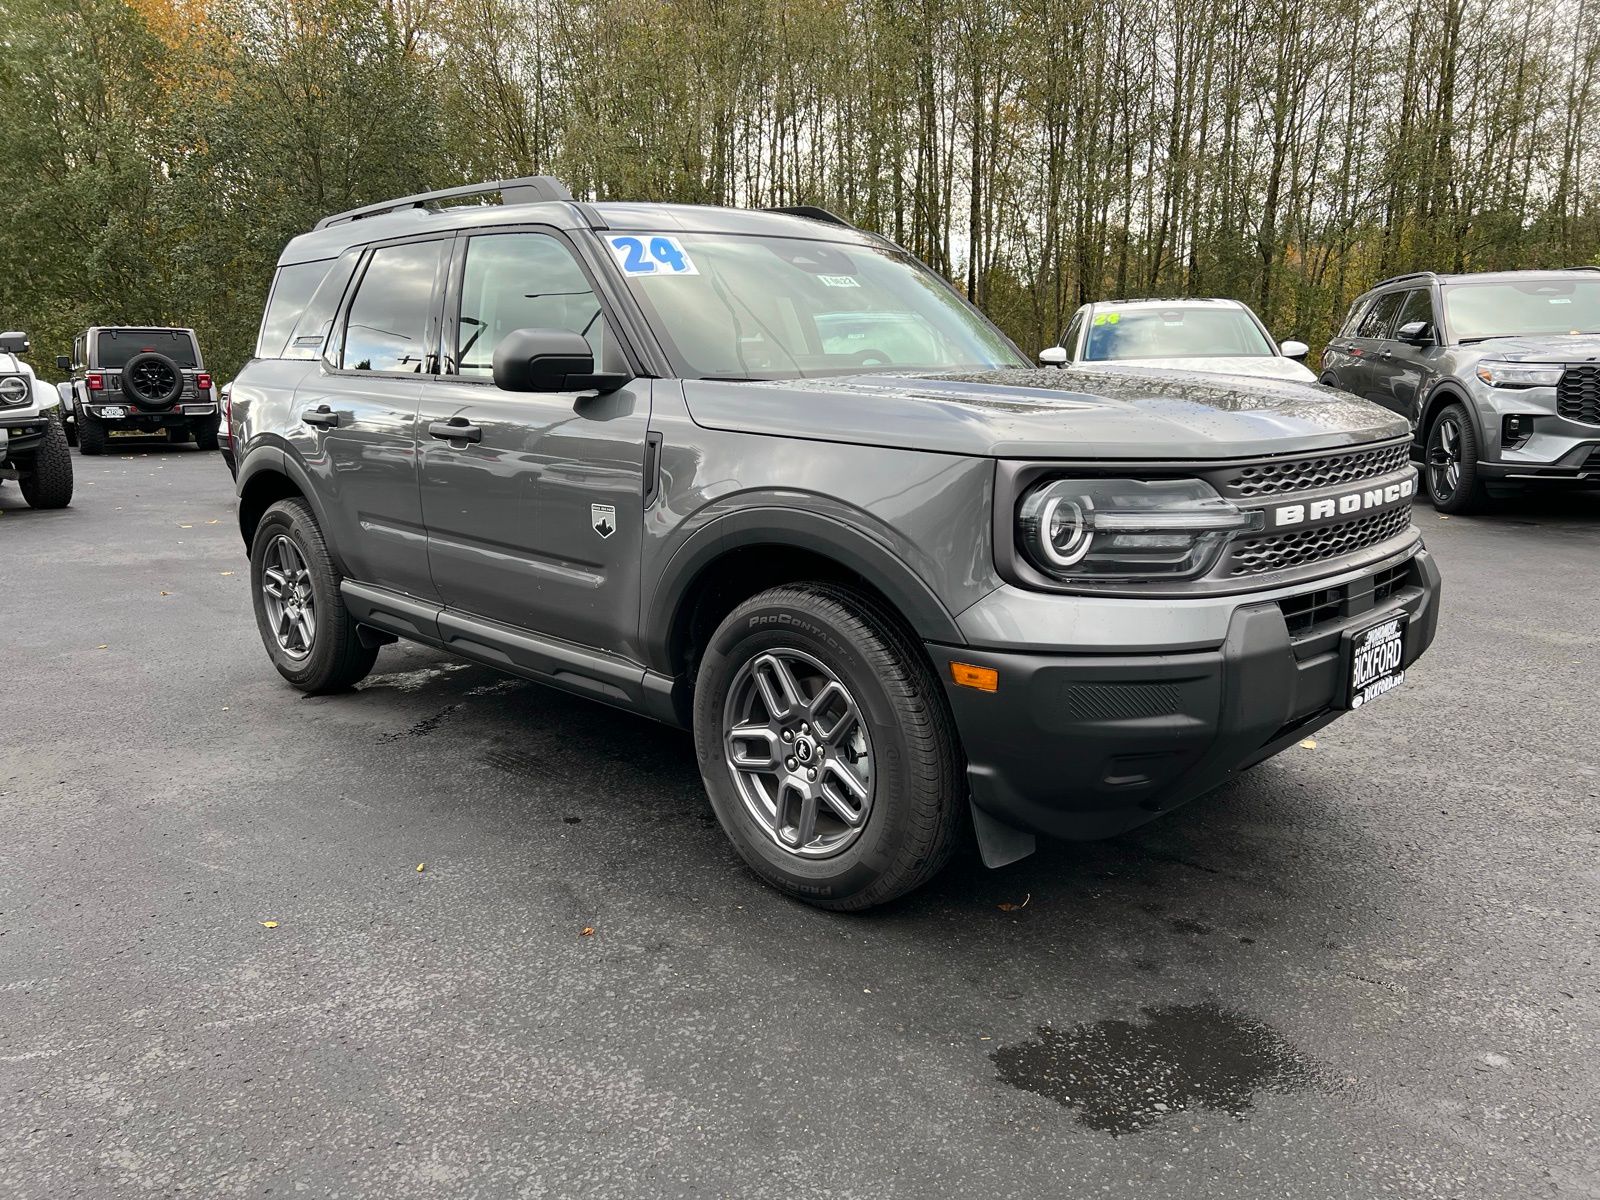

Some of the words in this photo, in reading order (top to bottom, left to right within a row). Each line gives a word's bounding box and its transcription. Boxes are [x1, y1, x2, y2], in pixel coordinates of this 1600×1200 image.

[611, 237, 686, 272] 24
[1276, 480, 1412, 526] BRONCO
[1353, 638, 1402, 688] BICKFORD
